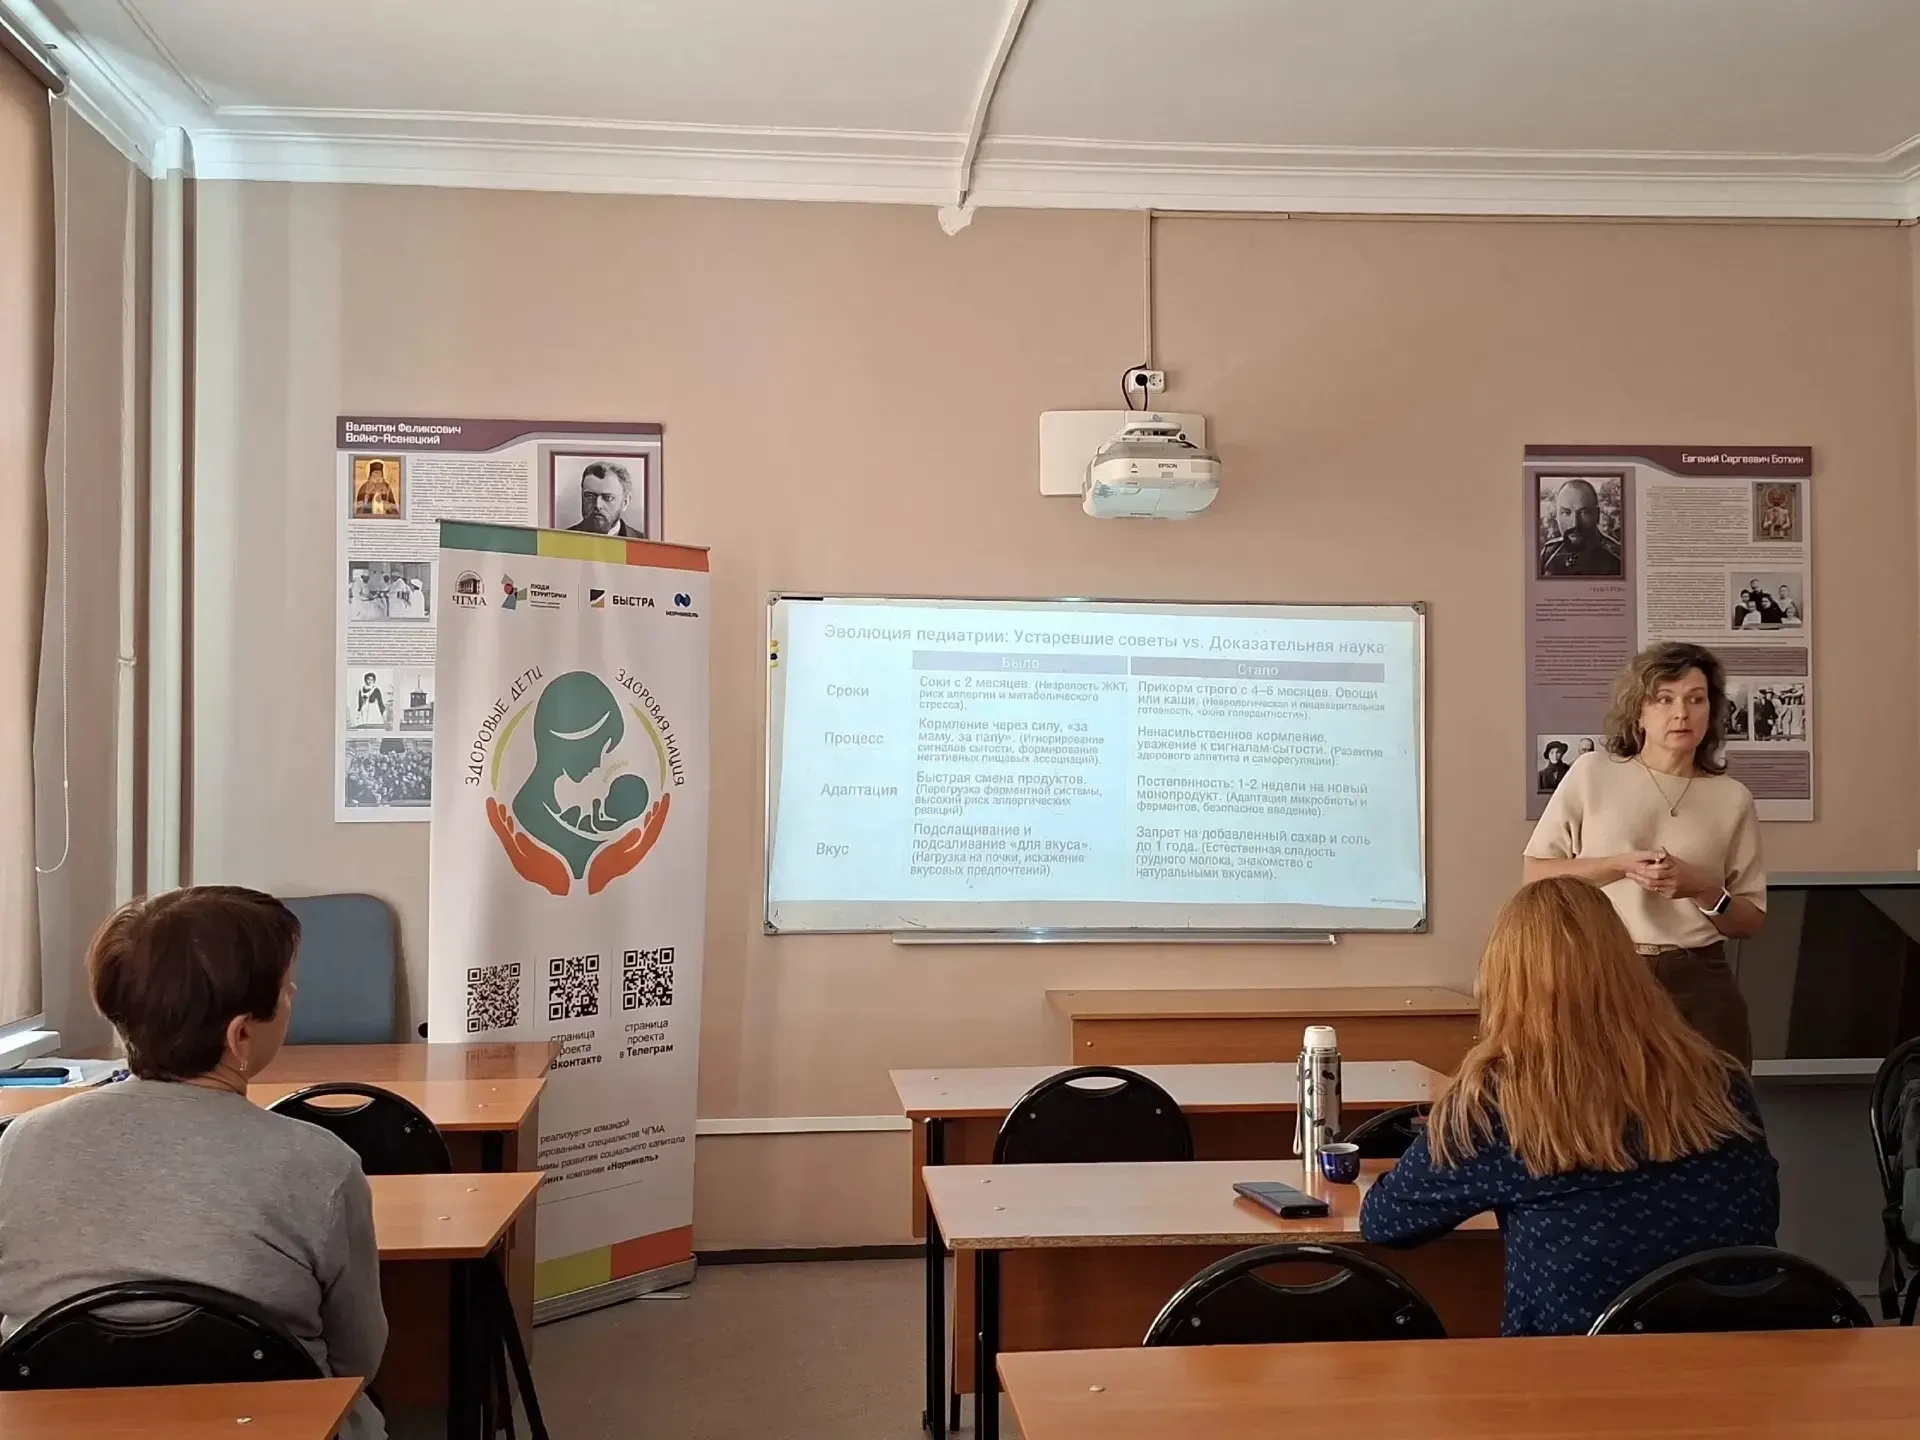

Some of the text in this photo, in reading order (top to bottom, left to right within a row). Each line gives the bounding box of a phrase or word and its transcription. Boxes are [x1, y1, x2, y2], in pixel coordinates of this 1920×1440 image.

[346, 421, 461, 434] Валентин Феликсович
[346, 432, 441, 444] Войно-Ясенецкий
[1682, 453, 1804, 465] Евгений Сергеевич Боткин
[453, 595, 487, 606] ЧГМА
[613, 595, 655, 608] БЫСТРА
[825, 624, 1384, 656] Эволюция педиатрии: Устаревшие советы vs. Доказательная наука
[1002, 657, 1039, 669] Было
[1237, 664, 1278, 677] Стало
[920, 676, 1128, 692] Соки с 2 месяцев. (Незрелость ЖКТ,
[1139, 681, 1193, 694] Прикорм
[1196, 685, 1238, 696] строго
[1241, 687, 1248, 695] с
[1278, 687, 1332, 698] месяцев.
[1336, 687, 1378, 700] Овощи
[827, 684, 870, 699] Сроки
[920, 690, 945, 700] риск
[947, 690, 996, 700] аллергии
[1009, 690, 1099, 702] метаболического
[1138, 695, 1160, 704] или
[1164, 695, 1199, 706] каши.
[1138, 706, 1193, 717] готовность,
[465, 666, 543, 786] ЗДОРОВЫЕ ДЕТИ
[615, 669, 670, 733] ЗДОРОВАЯ
[664, 733, 685, 787] НАЦИЯ
[919, 718, 1088, 733] Кормление через силу, «за
[824, 731, 884, 747] Процесс
[918, 732, 954, 744] маму,
[959, 733, 972, 742] за
[1020, 733, 1104, 746] (Игнорирование
[1138, 726, 1328, 744] Ненасильственное кормление,
[918, 743, 966, 752] сигналов
[1018, 744, 1098, 756] формирование
[1137, 740, 1197, 751] уважение
[1200, 742, 1207, 750] к
[1210, 742, 1269, 754] сигналам
[1272, 744, 1326, 755] сытости.
[917, 753, 979, 763] негативных
[982, 754, 1030, 764] пищевых
[1137, 752, 1191, 762] здорового
[1194, 753, 1240, 763] аппетита
[917, 771, 1087, 787] Быстрая смена продуктов.
[1137, 775, 1234, 789] Постепенность:
[1261, 781, 1306, 792] недели
[1310, 783, 1324, 792] на
[1328, 782, 1368, 794] новый
[821, 783, 898, 799] Адаптация
[916, 784, 1102, 797] (Перегрузка ферментной системы,
[915, 794, 1072, 807] высокий риск аллергических
[1137, 790, 1367, 807] монопродукт. (Адаптация микробиоты и
[1136, 801, 1200, 812] ферментов,
[1203, 803, 1264, 814] безопасное
[913, 822, 1032, 837] Подслащивание и
[1136, 826, 1371, 845] Запрет на добавленный сахар и соль
[816, 842, 850, 857] Вкус
[912, 839, 1006, 851] подсаливание
[1010, 840, 1041, 851] «для
[1136, 840, 1336, 858] до 1 года. (Естественная сладость
[912, 851, 1085, 864] (Нагрузка на почки, искажение
[1136, 855, 1313, 869] грудного молока, знакомство с
[910, 866, 964, 877] вкусовых
[1136, 867, 1219, 880] натуральными
[625, 1019, 669, 1033] страница
[551, 1030, 595, 1045] страница
[628, 1032, 665, 1045] проекта
[560, 1043, 592, 1057] роекта
[620, 1044, 674, 1059] в Телеграм
[540, 1118, 630, 1145] реализуется командой
[588, 1130, 640, 1149] специалистов
[642, 1124, 665, 1138] ЧГМА
[561, 1154, 598, 1169] развития
[600, 1141, 647, 1160] социального
[649, 1134, 686, 1149] капитала
[566, 1166, 605, 1181] компании
[607, 1153, 659, 1171] «Норникель»
